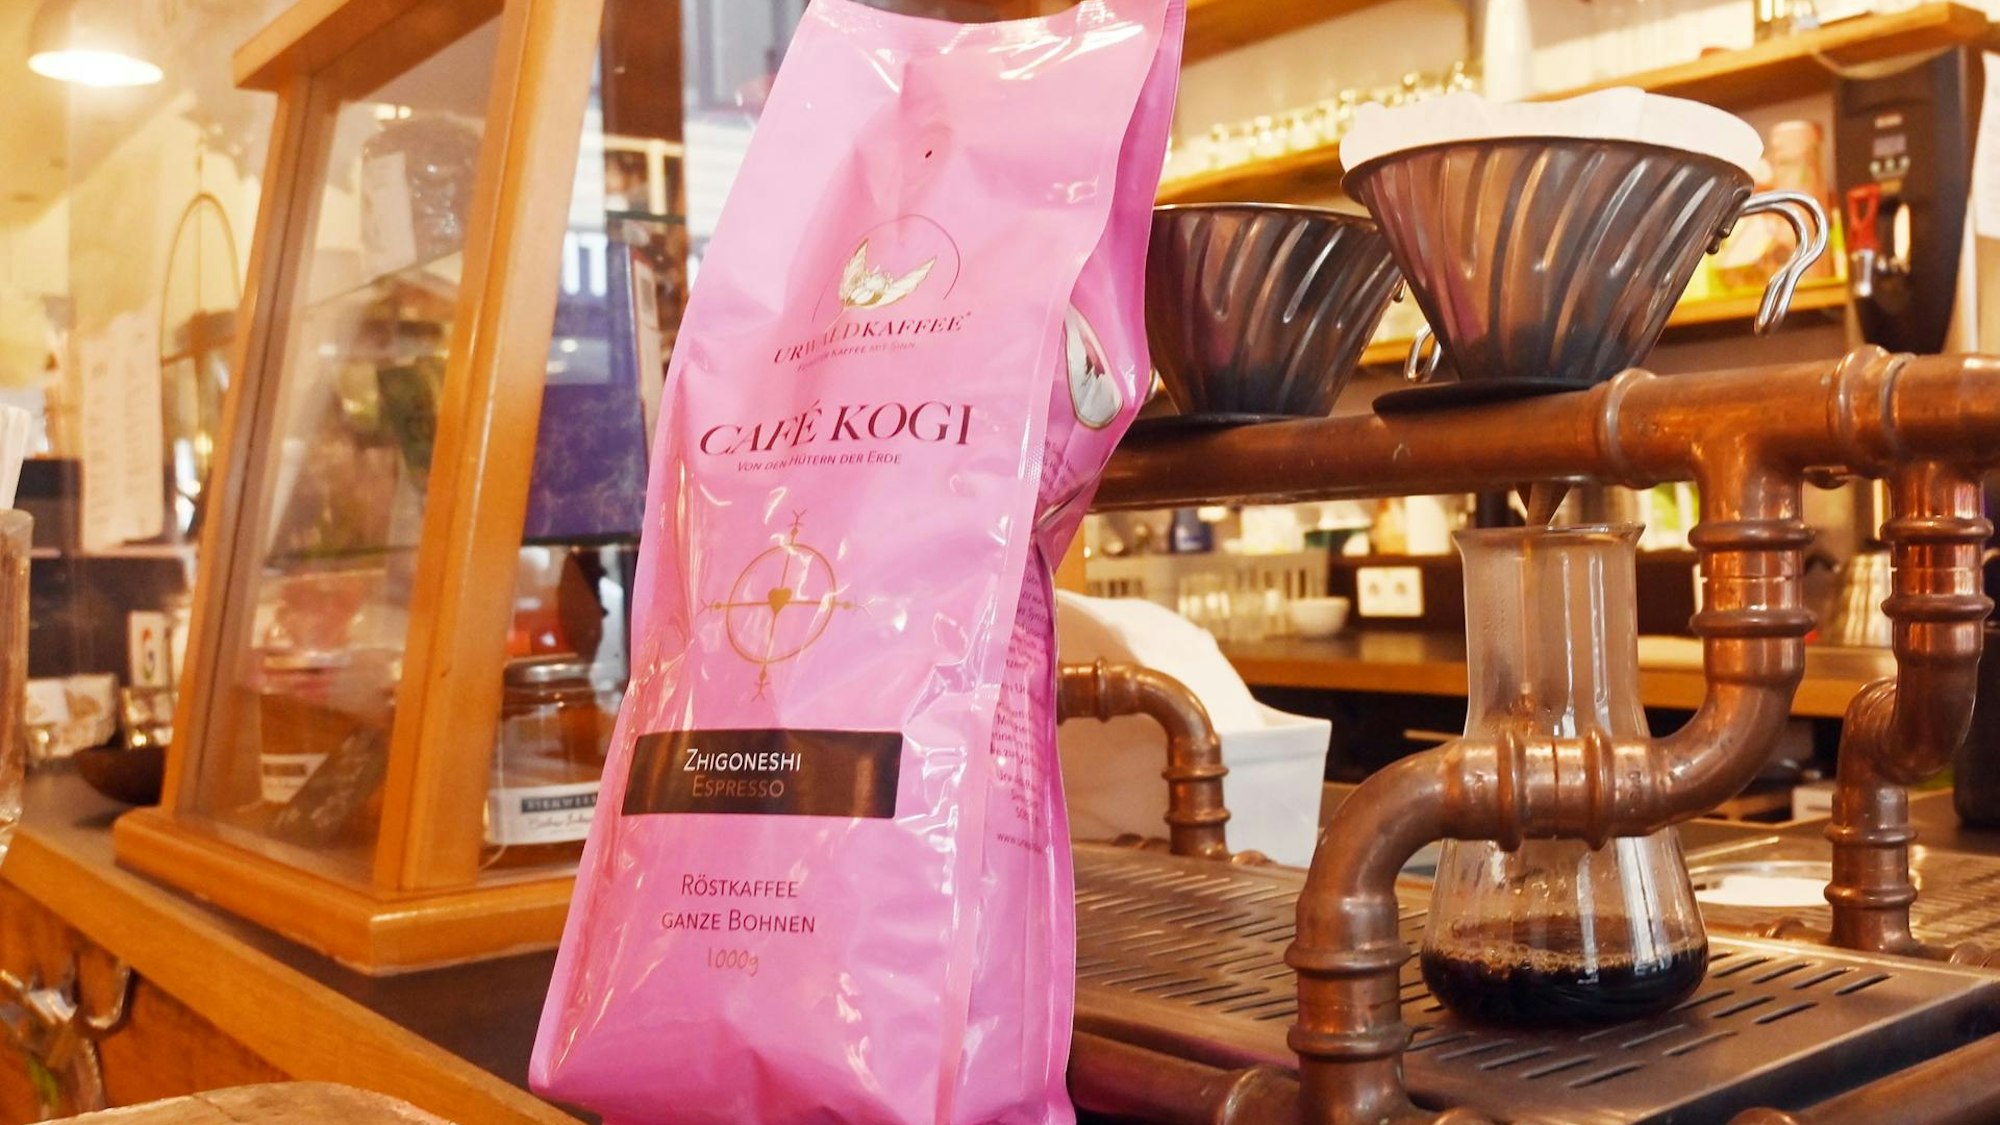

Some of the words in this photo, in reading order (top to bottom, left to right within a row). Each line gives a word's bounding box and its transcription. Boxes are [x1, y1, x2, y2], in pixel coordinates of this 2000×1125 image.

[700, 400, 822, 456] CAFÉ
[829, 401, 975, 445] KOGI
[737, 461, 762, 472] VON
[764, 460, 788, 471] DEN
[787, 456, 836, 467] HÜTERN
[839, 453, 863, 464] DER
[866, 449, 903, 465] ERDE
[683, 748, 802, 772] ZHIGONESHI
[691, 774, 785, 799] ESPRESSO
[681, 874, 799, 898] RÖSTKAFFEE
[661, 912, 721, 931] GANZE
[728, 909, 816, 934] BOHNEN
[707, 948, 759, 976] 1000g
